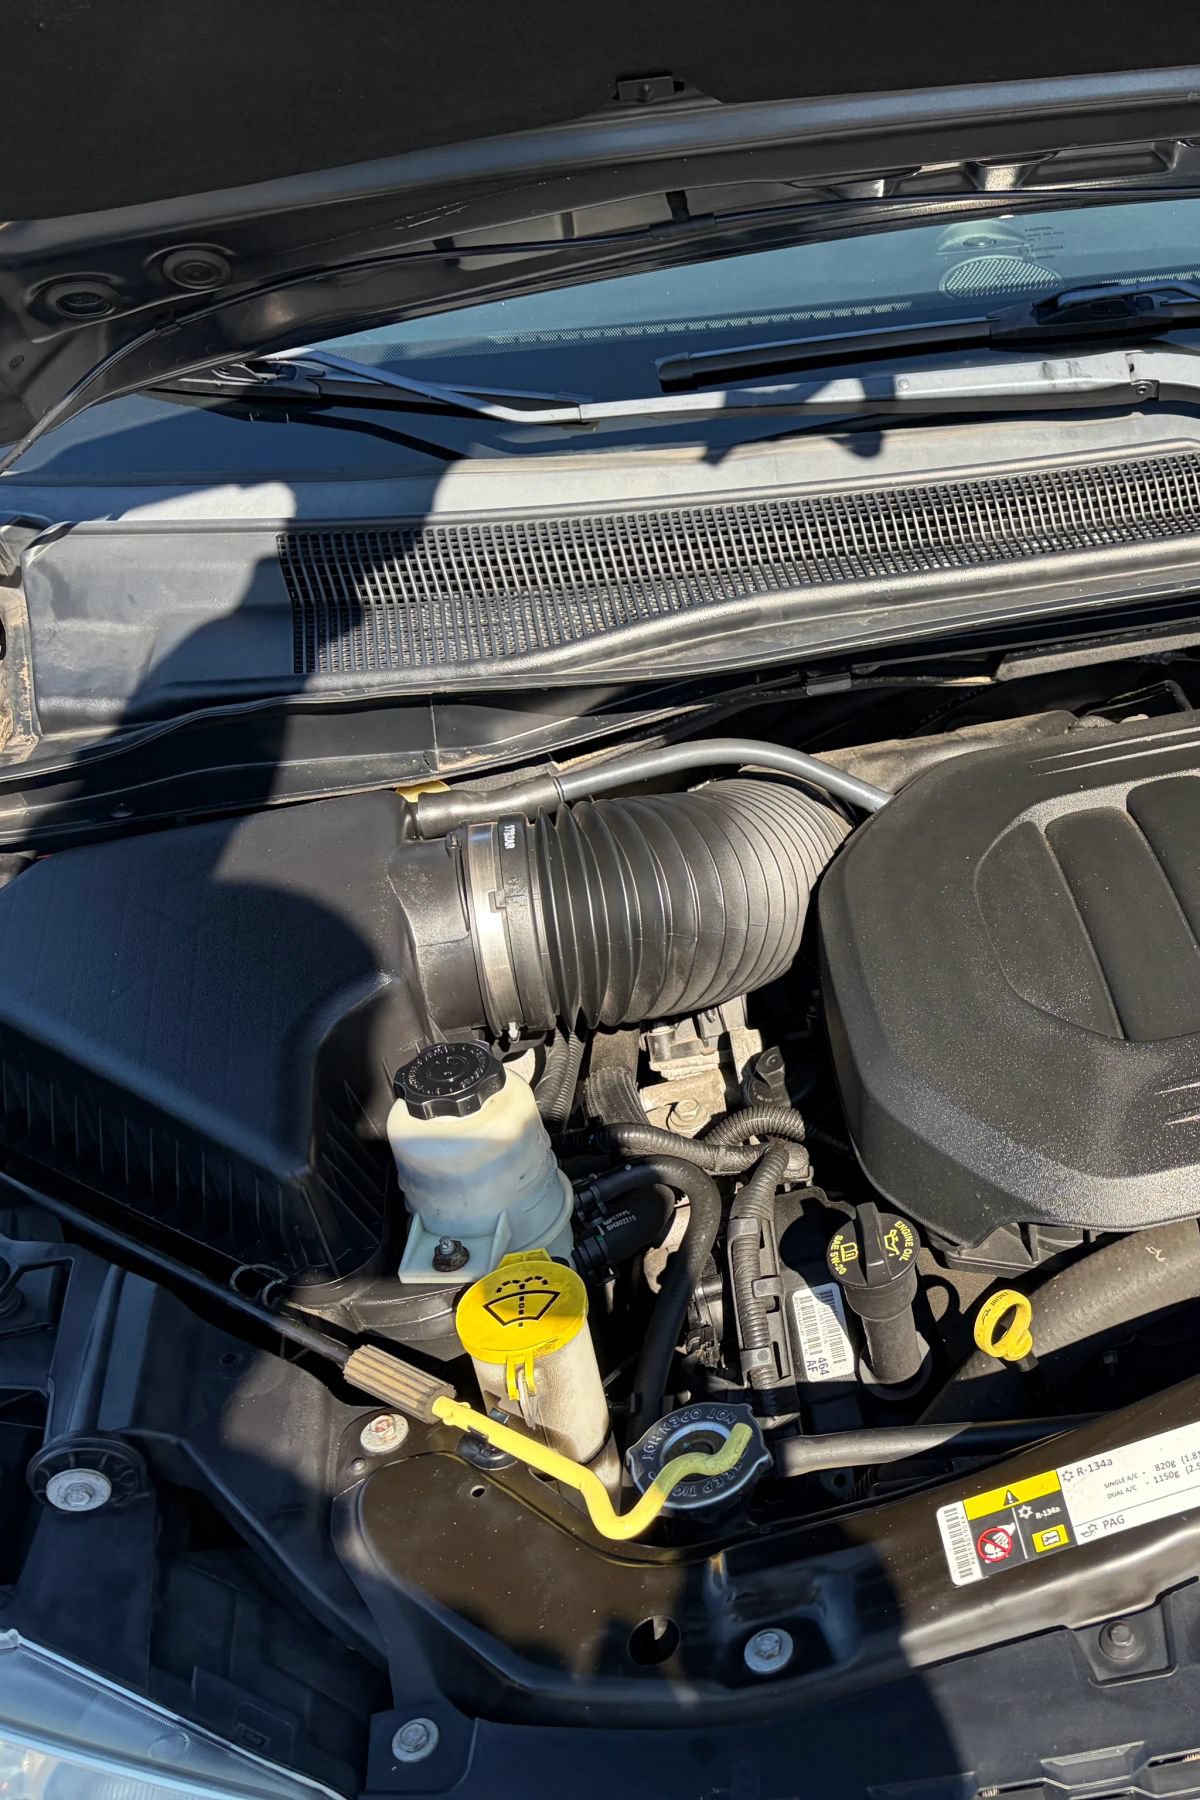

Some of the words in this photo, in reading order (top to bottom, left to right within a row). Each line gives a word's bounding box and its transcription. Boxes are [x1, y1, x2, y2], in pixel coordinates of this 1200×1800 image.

[831, 1235, 844, 1250] SAE
[894, 1220, 913, 1247] ENGINE
[830, 1251, 847, 1275] 5W-20
[899, 1249, 913, 1261] OIL
[806, 1360, 818, 1373] AF
[816, 1357, 830, 1376] 464
[659, 1409, 702, 1434] OPEN
[706, 1408, 737, 1424] NOT
[642, 1436, 661, 1460] HOT
[1076, 1459, 1113, 1476] R-134a
[1104, 1477, 1125, 1489] SINGLE
[1127, 1473, 1139, 1481] A/C
[1154, 1460, 1177, 1472] 820g
[1107, 1490, 1124, 1499] DUAL
[1125, 1485, 1137, 1493] A/C
[1153, 1470, 1180, 1484] 1150g
[1035, 1506, 1061, 1520] R-134a
[1102, 1514, 1125, 1530] PAG
